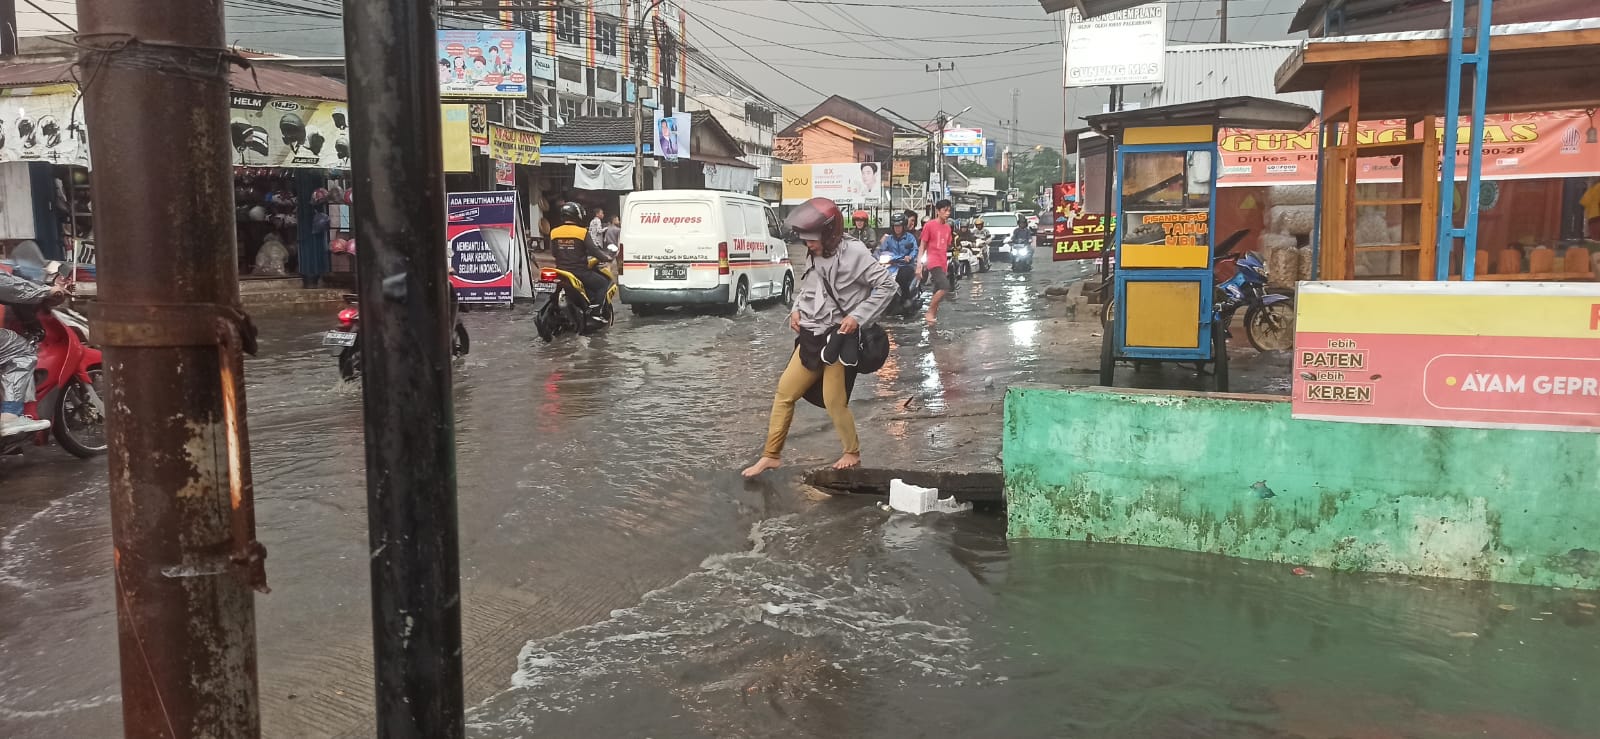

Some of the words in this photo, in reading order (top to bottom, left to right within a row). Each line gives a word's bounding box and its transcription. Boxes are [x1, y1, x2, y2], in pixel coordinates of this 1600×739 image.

[1115, 7, 1162, 20] KEMPLANG
[1070, 65, 1126, 78] GUNUNG
[1128, 63, 1158, 75] MAS
[233, 97, 262, 106] HELM
[786, 177, 808, 186] YOU
[450, 198, 462, 206] ADA
[463, 197, 495, 205] PEMUTIHAN
[495, 195, 514, 204] PAJAK
[640, 215, 661, 224] TAM
[662, 215, 702, 225] express
[1162, 222, 1208, 235] TAHU
[456, 241, 481, 251] MEMBANTU
[733, 239, 746, 251] TAM
[746, 241, 765, 252] express
[1056, 238, 1106, 254] HAPP
[460, 253, 475, 262] PAJAK
[475, 252, 497, 262] KENDARA
[458, 264, 479, 274] SELURUH
[1328, 339, 1356, 349] lebih
[1302, 352, 1364, 368] PATEN
[1317, 371, 1345, 381] lebih
[1460, 373, 1526, 394] AYAM
[1532, 375, 1600, 396] GEPR
[1307, 385, 1371, 402] KEREN
